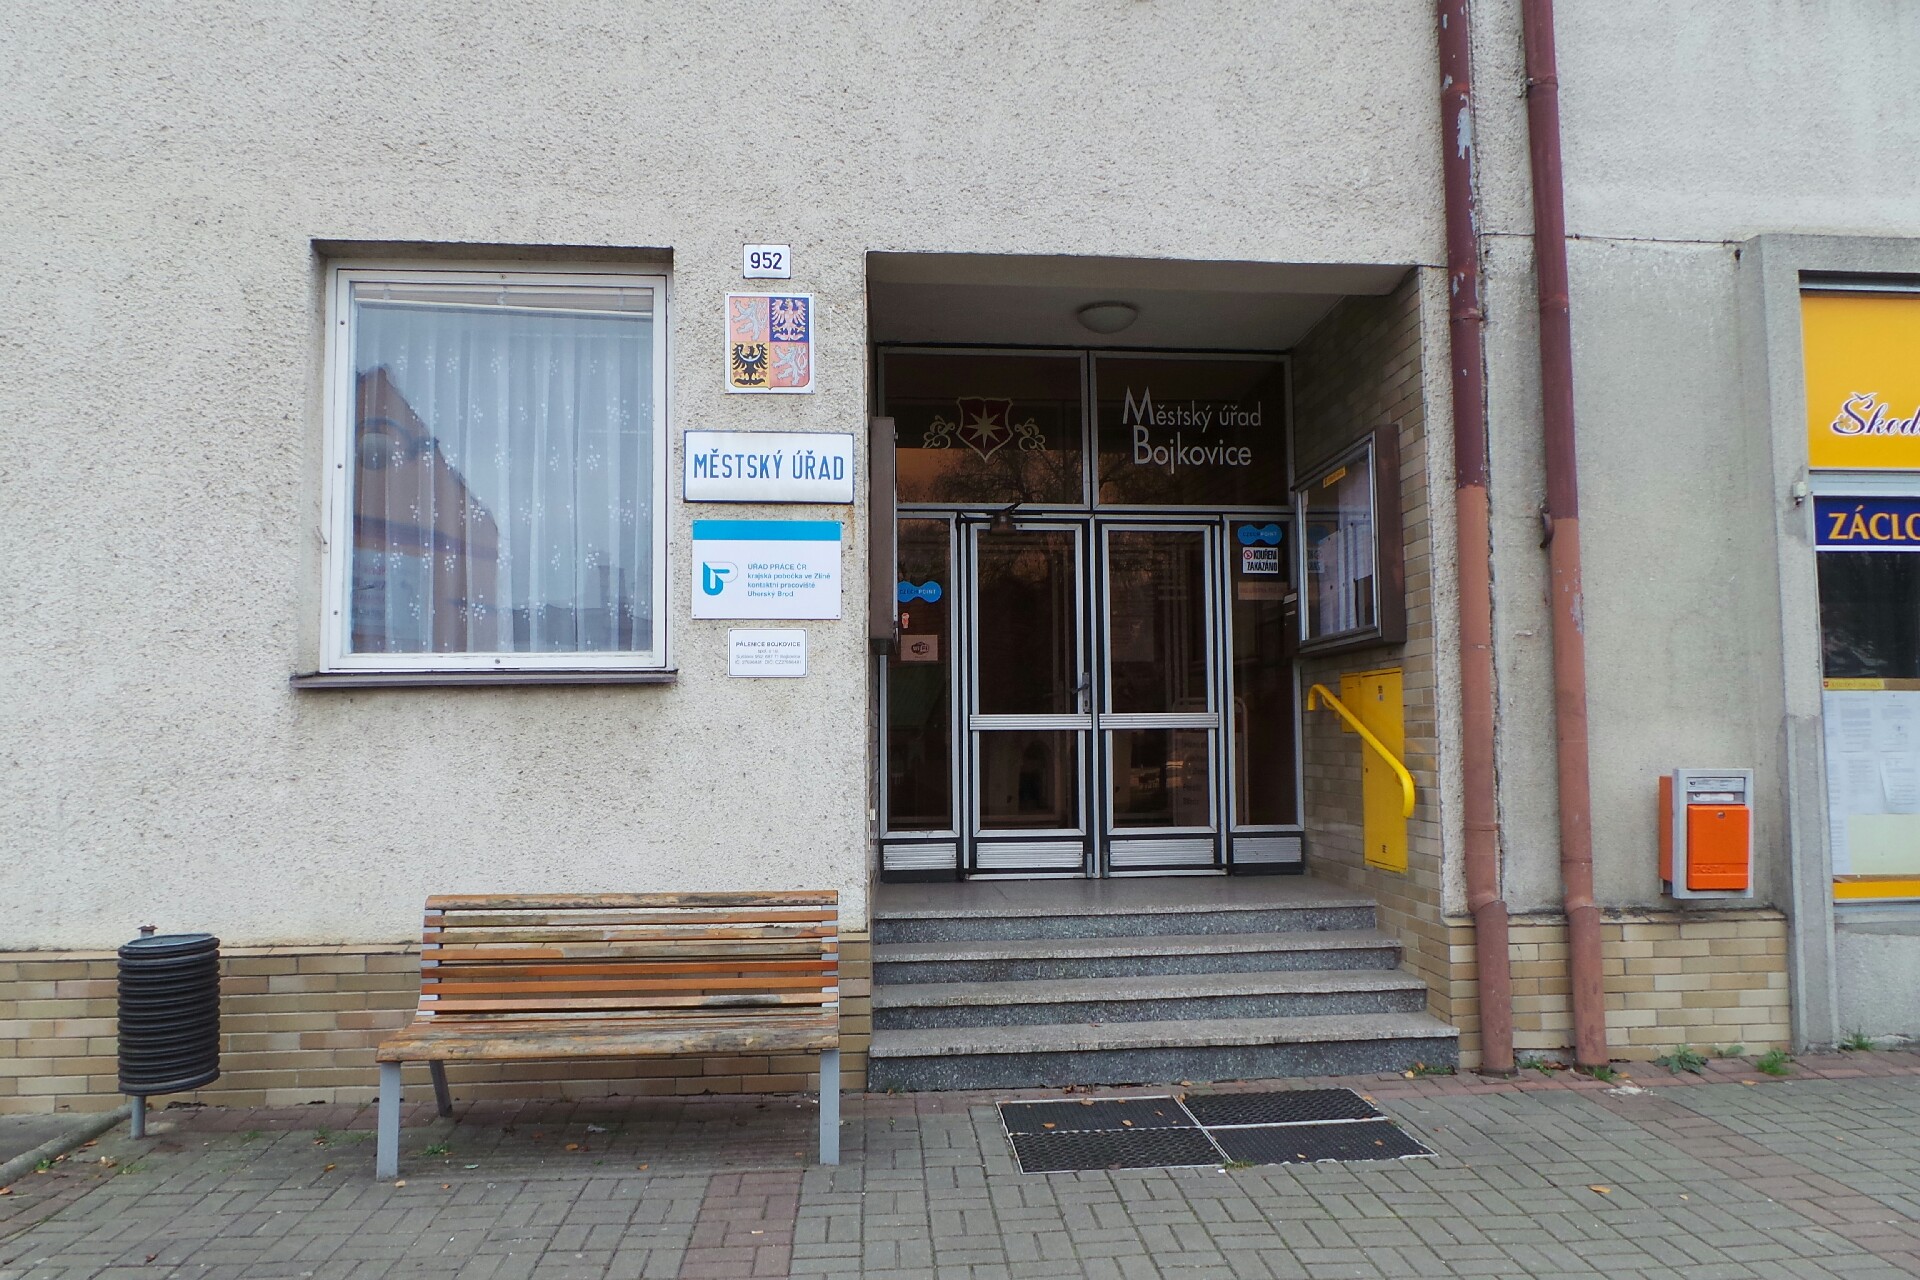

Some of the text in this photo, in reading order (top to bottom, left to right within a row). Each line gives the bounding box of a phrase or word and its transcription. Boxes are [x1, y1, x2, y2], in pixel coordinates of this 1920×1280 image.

[750, 252, 782, 270] 952
[1122, 386, 1262, 433] Městský úřad
[1133, 425, 1253, 475] Bojkovice
[693, 448, 844, 481] MĚSTSKÝ ÚŘAD
[770, 562, 795, 571] PRÁCE
[747, 572, 772, 581] krajská
[773, 572, 803, 581] pobočka
[747, 590, 794, 599] Uherský Brod
